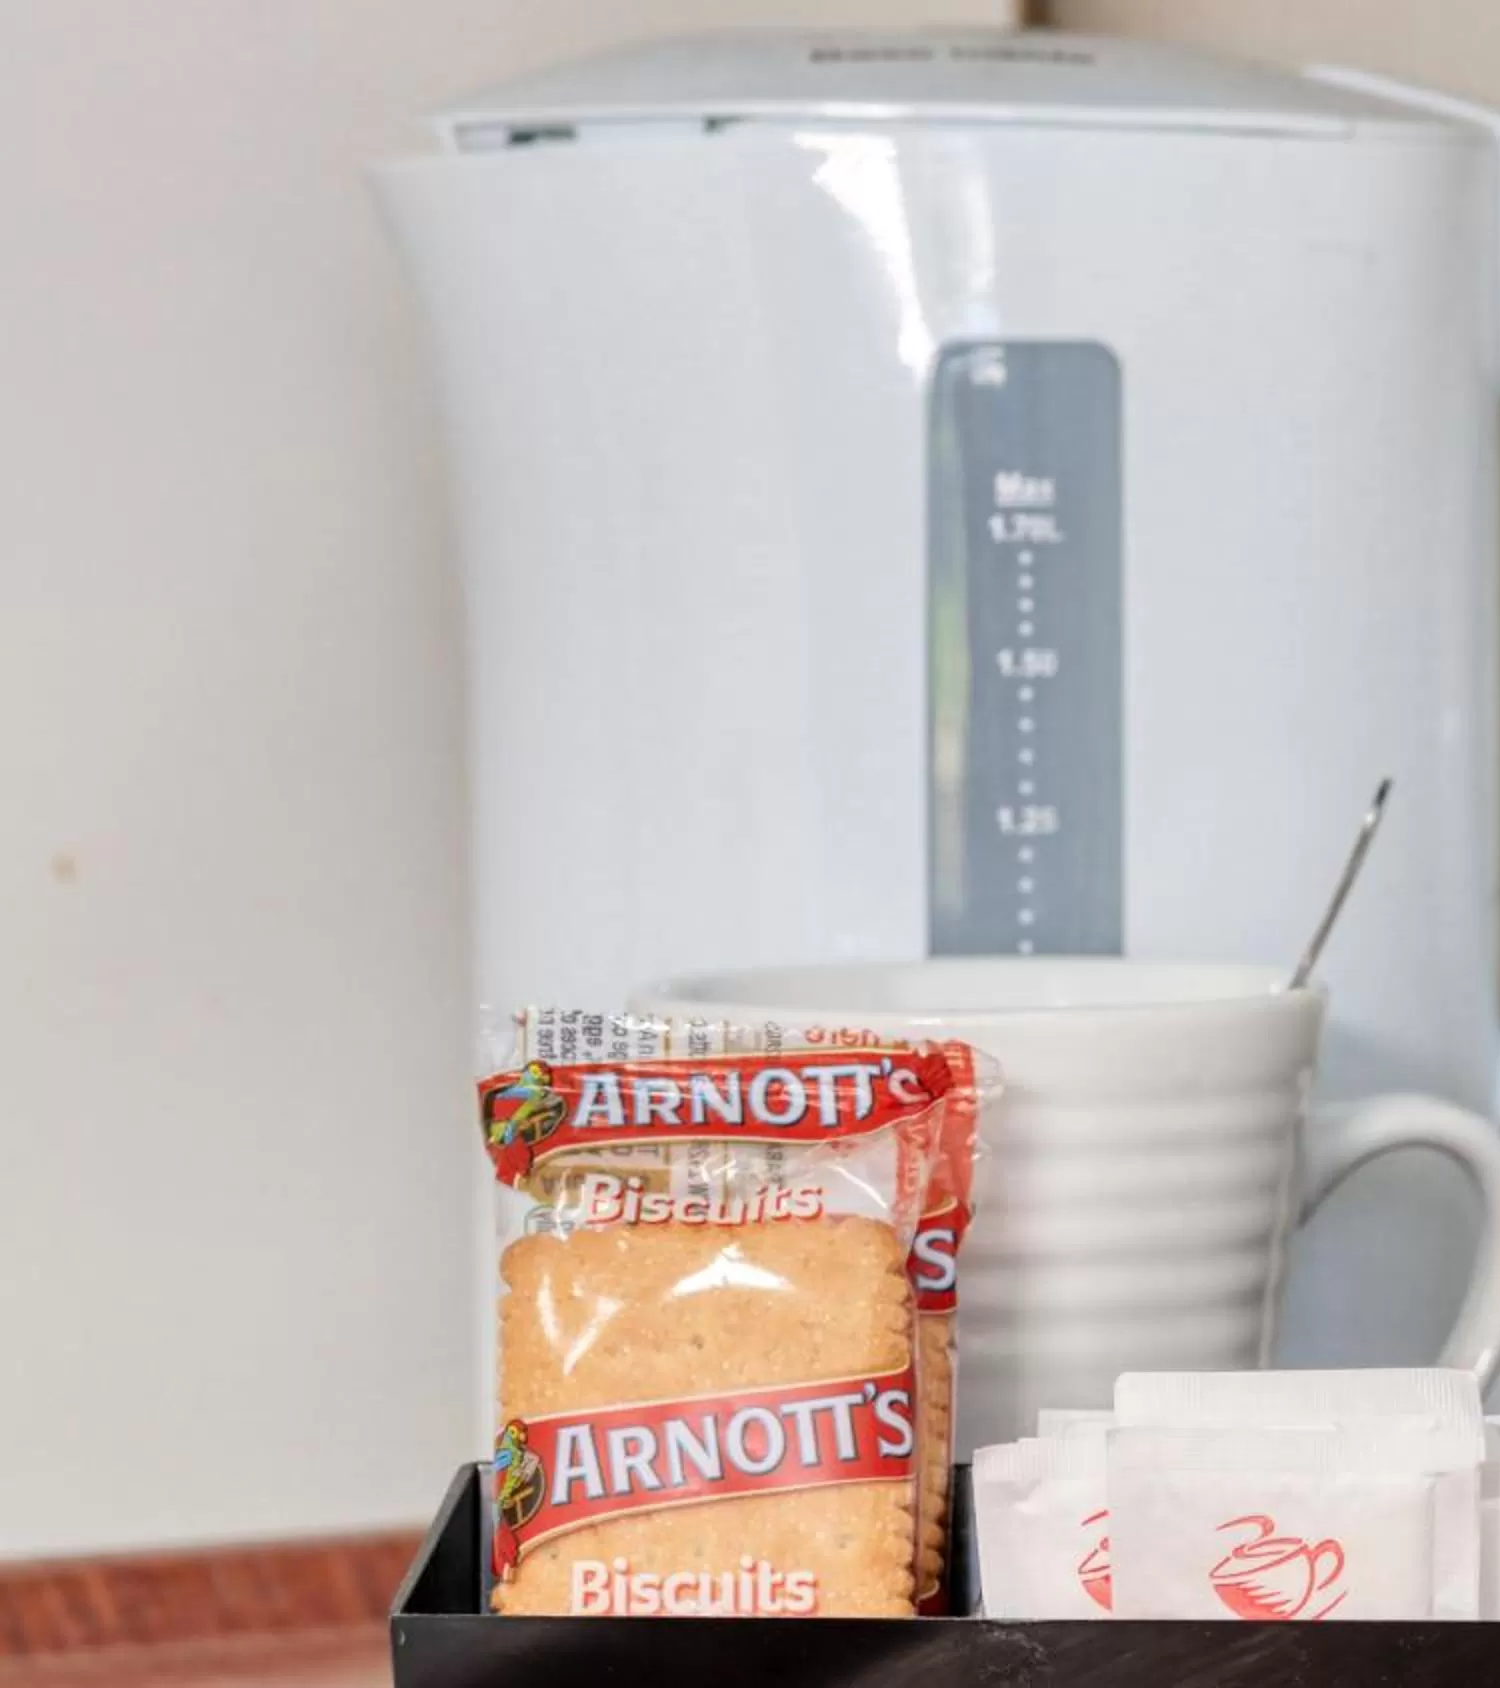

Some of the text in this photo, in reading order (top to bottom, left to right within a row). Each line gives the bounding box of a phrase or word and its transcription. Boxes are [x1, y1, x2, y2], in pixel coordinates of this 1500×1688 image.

[578, 1173, 824, 1227] Biscuits
[551, 1382, 914, 1506] ARNOTT'S
[570, 1556, 818, 1615] Biscuits
